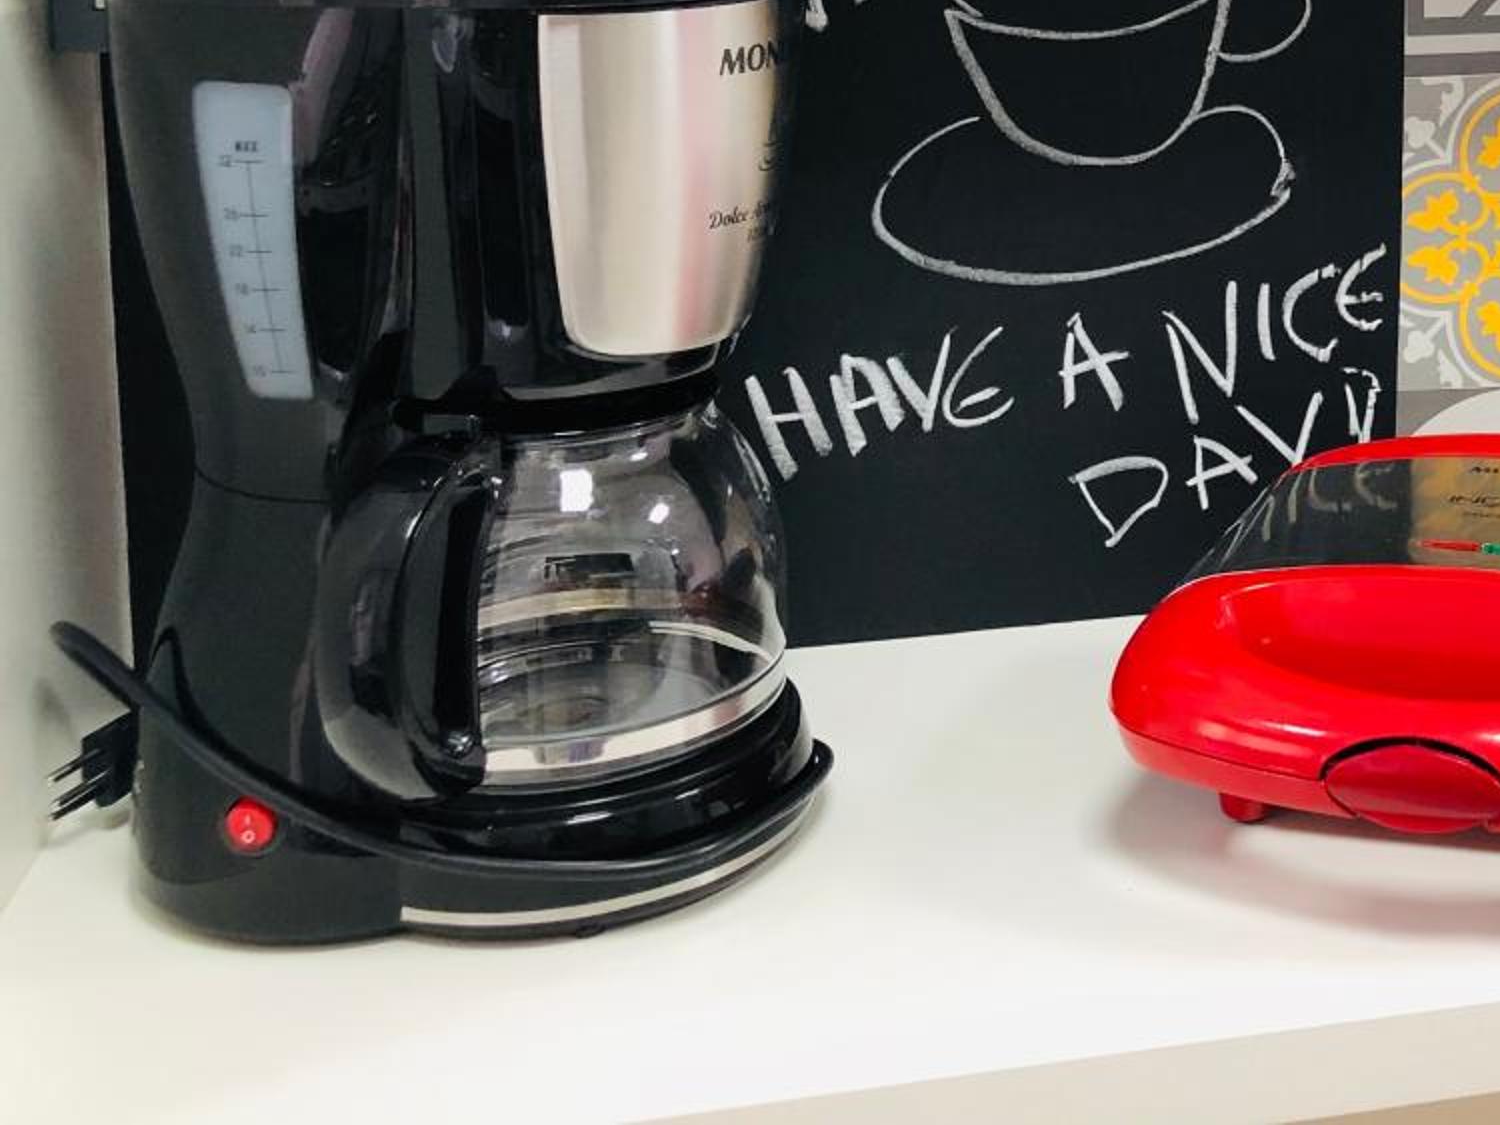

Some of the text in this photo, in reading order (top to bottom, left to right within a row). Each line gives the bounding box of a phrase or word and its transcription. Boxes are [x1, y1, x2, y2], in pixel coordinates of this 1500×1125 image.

[745, 242, 1387, 480] HAVE A NICE
